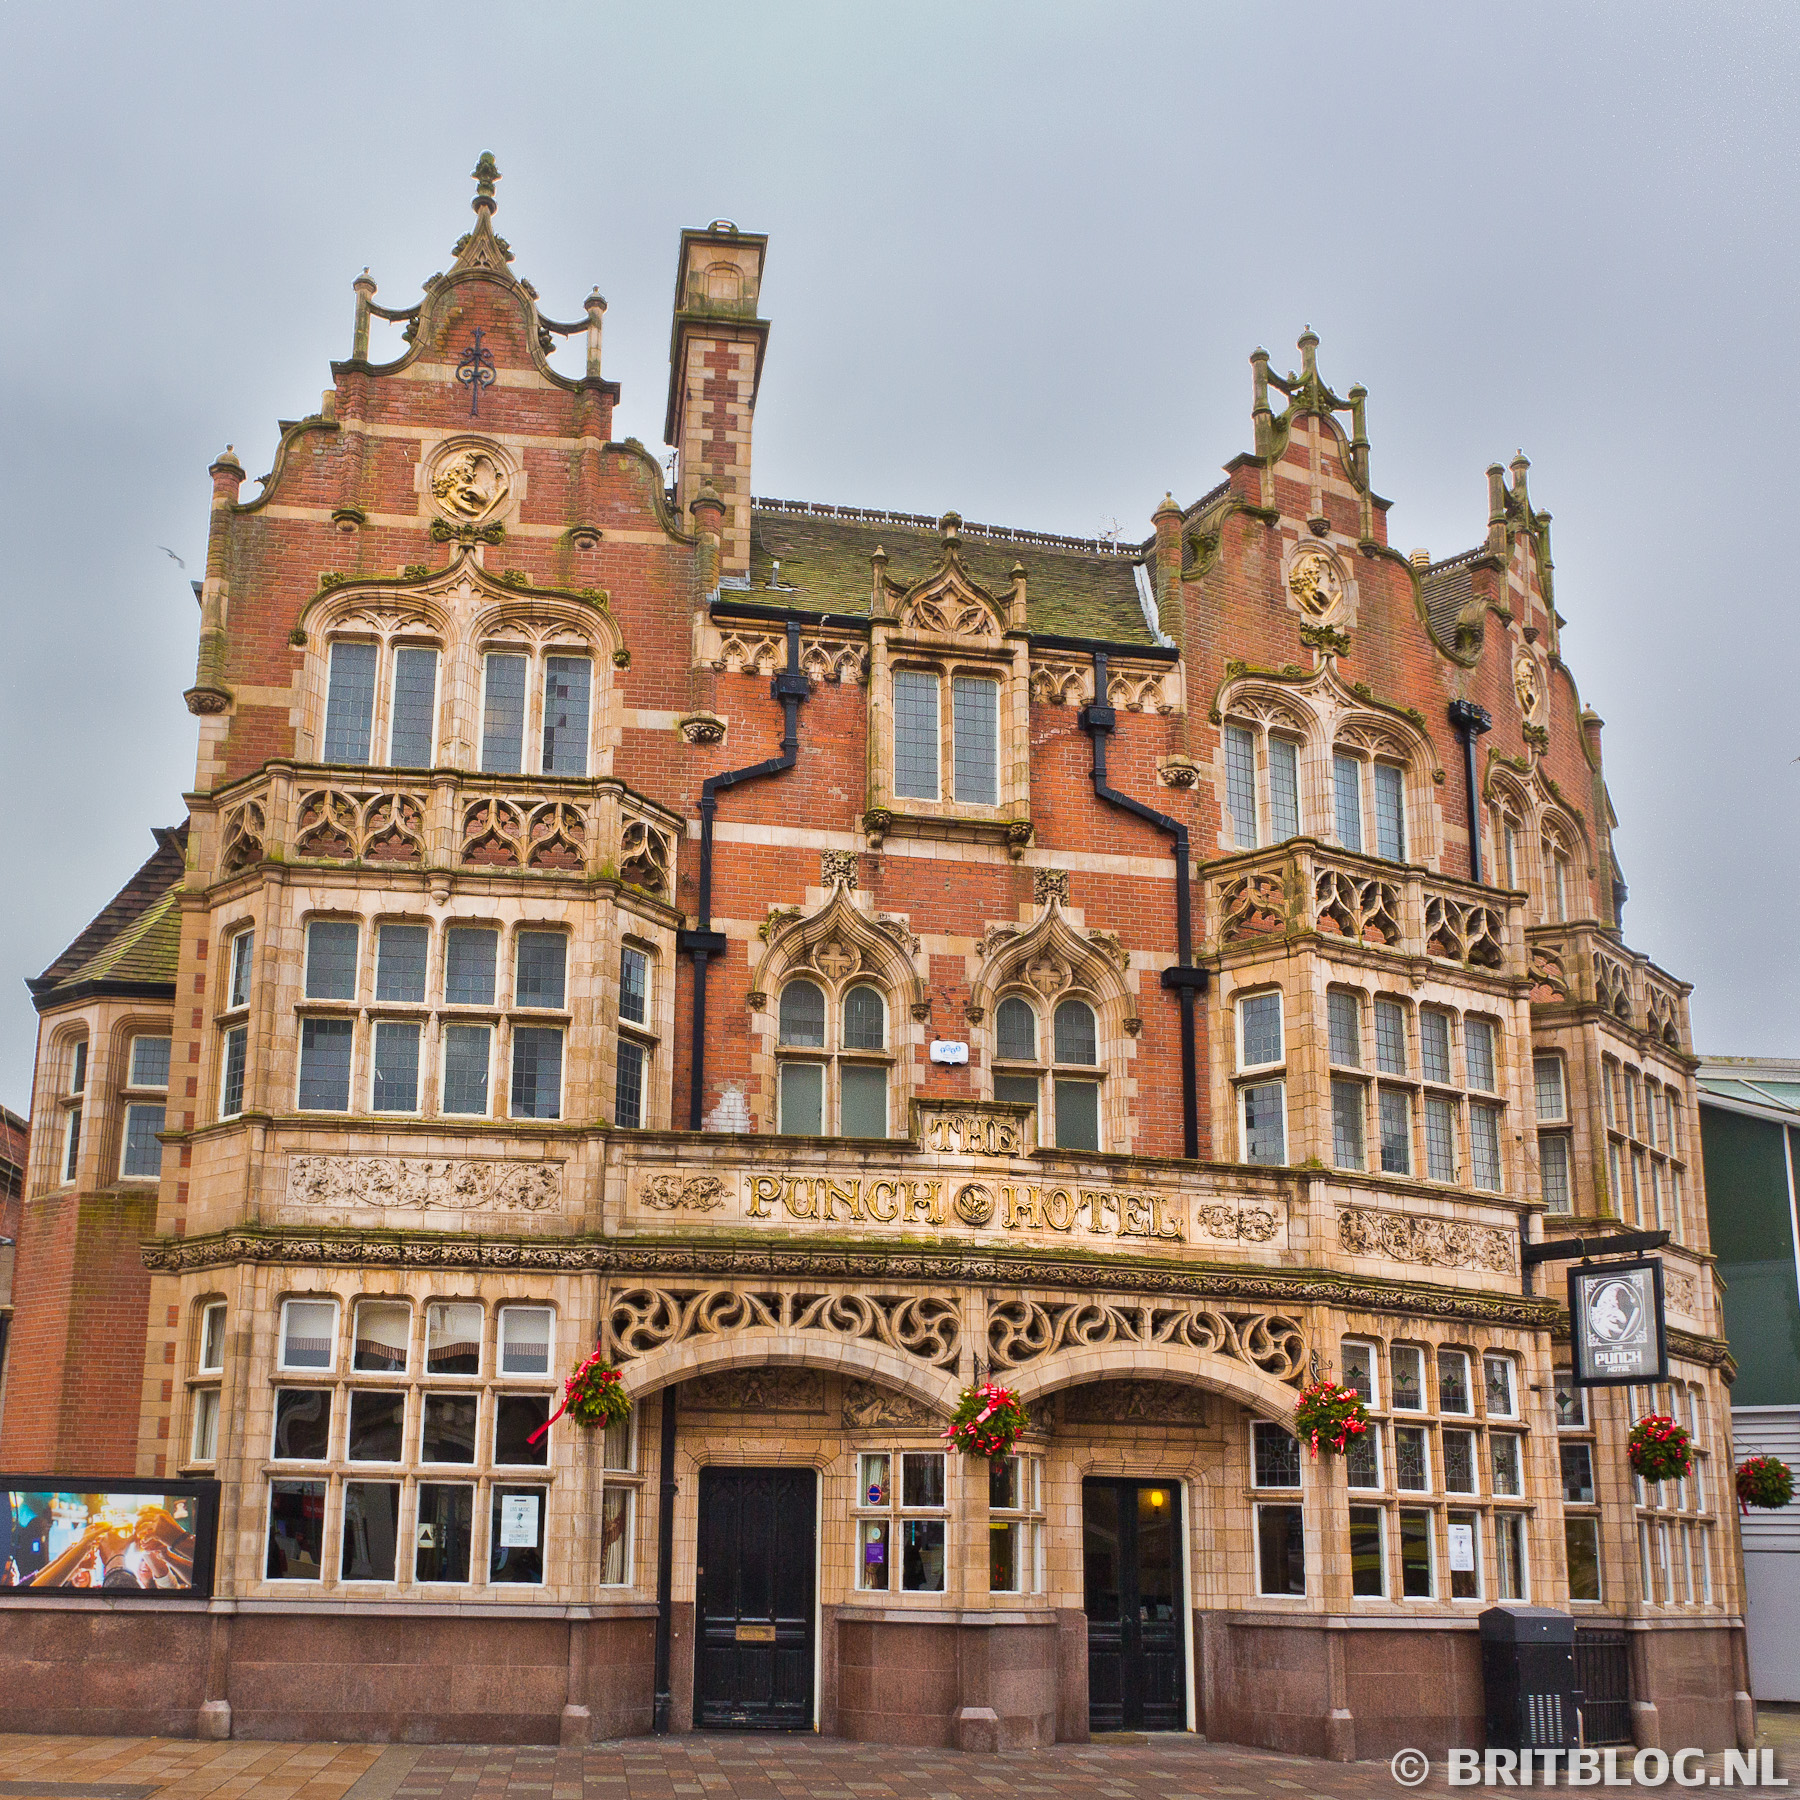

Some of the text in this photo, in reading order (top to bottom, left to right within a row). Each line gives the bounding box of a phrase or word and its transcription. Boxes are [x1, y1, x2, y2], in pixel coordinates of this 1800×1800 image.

[928, 1116, 1020, 1155] THE
[745, 1174, 1185, 1241] PUNCH HOTEL
[1595, 1351, 1641, 1365] PUNCH
